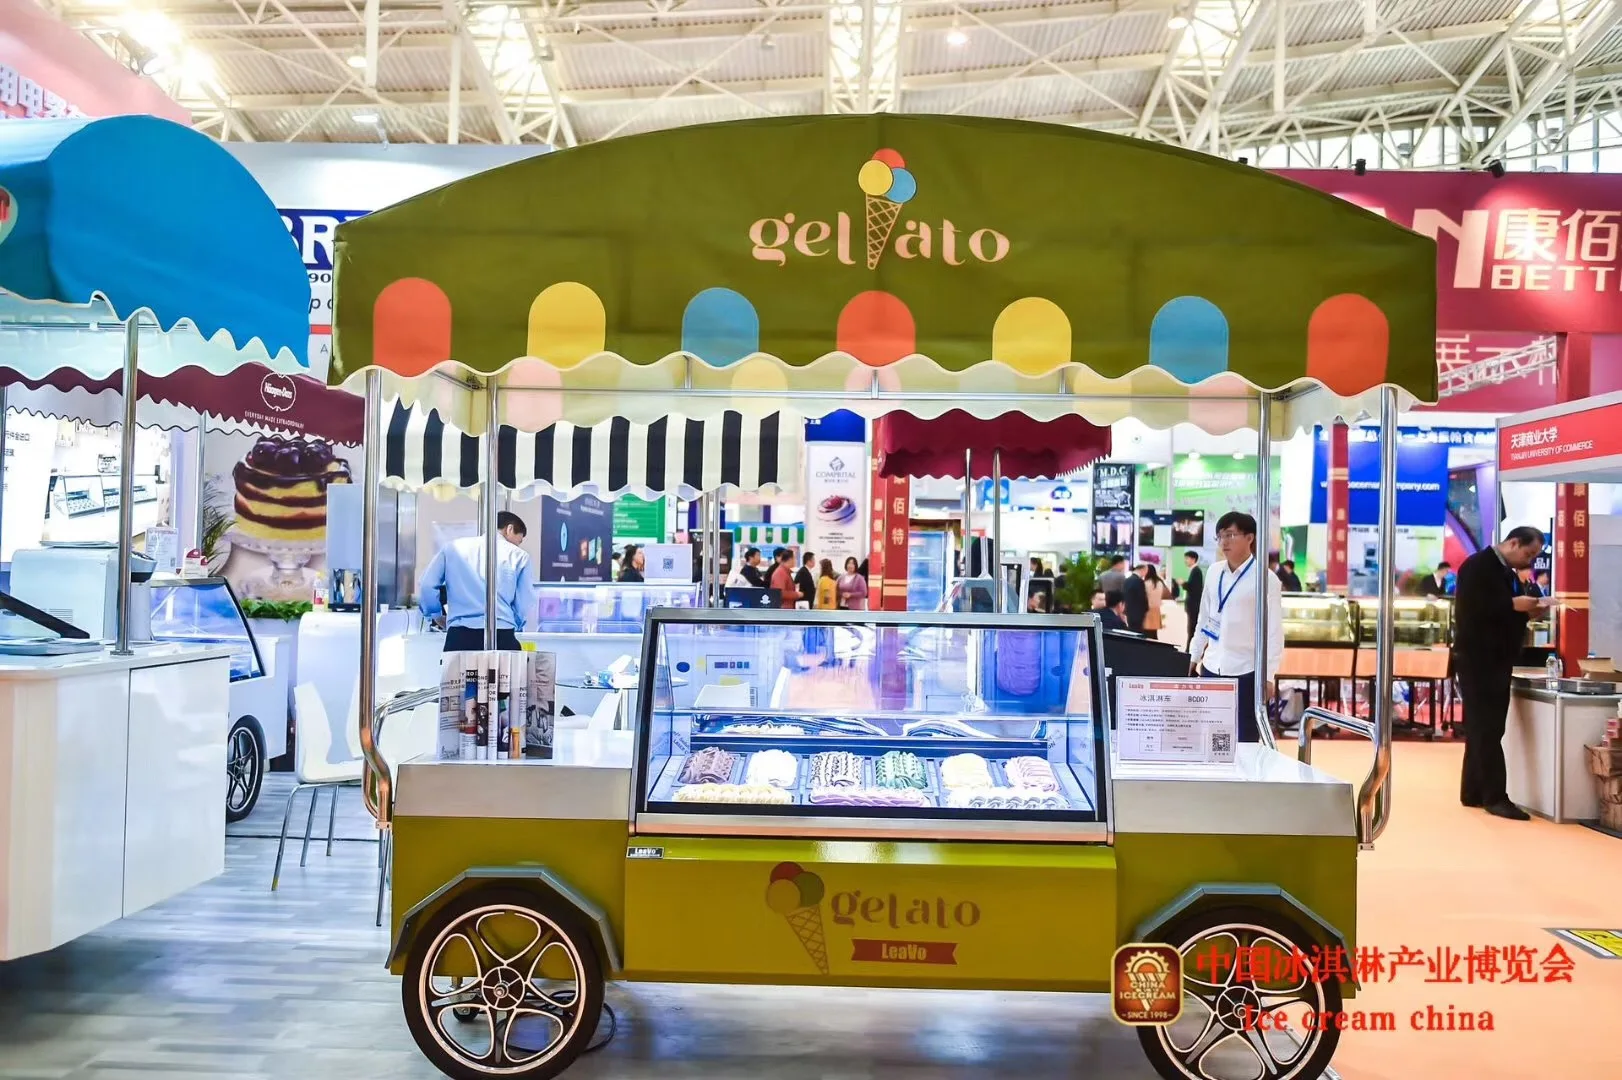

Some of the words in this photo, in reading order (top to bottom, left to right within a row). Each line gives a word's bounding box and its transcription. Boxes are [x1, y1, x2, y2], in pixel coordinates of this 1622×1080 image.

[749, 211, 1010, 267] gelato
[1510, 426, 1558, 449] 天津商业大学
[831, 890, 981, 929] gelato
[881, 943, 928, 961] LeaVo
